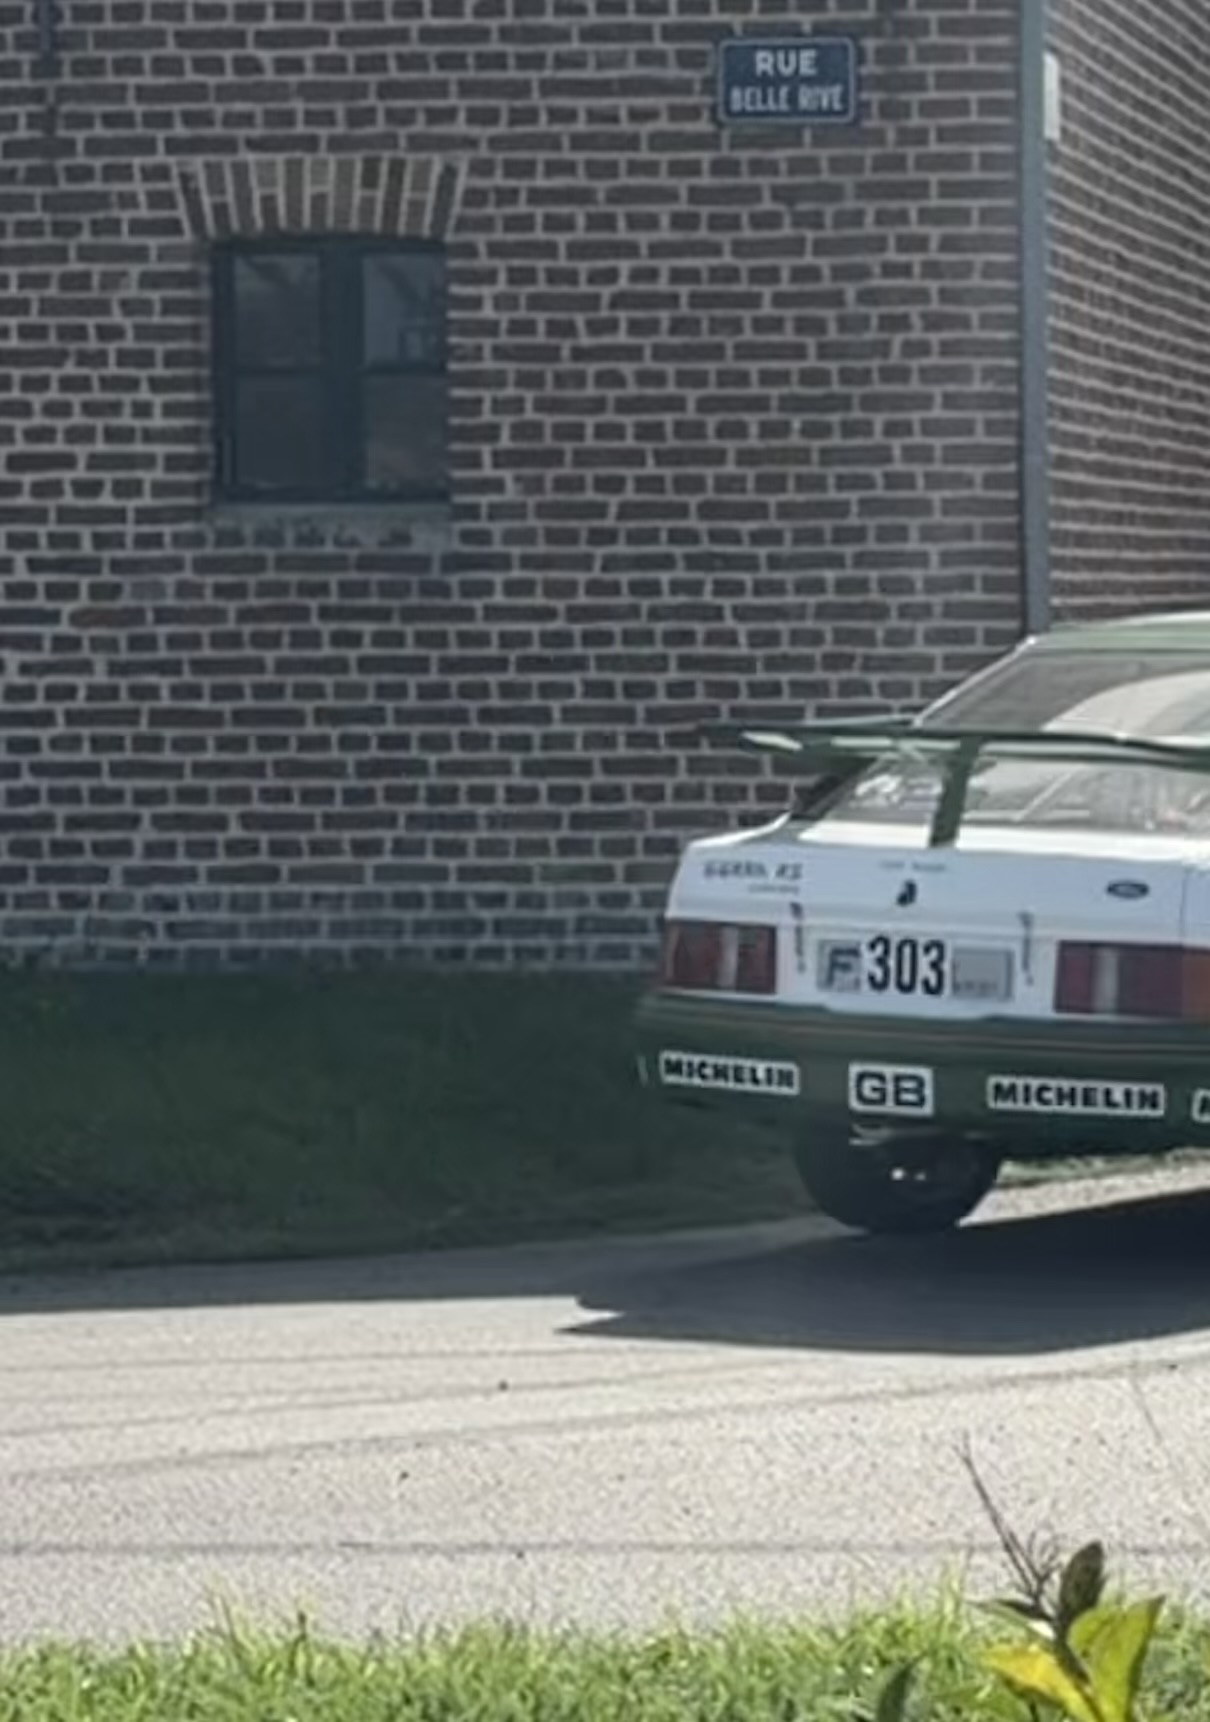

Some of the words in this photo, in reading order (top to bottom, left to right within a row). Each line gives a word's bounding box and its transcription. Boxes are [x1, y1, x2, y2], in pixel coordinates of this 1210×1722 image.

[755, 49, 818, 77] RUE
[729, 85, 790, 113] BELLE
[868, 935, 946, 996] 303
[664, 1056, 796, 1089] MICHELIN
[854, 1070, 927, 1108] GB
[993, 1082, 1161, 1112] MICHELIN
